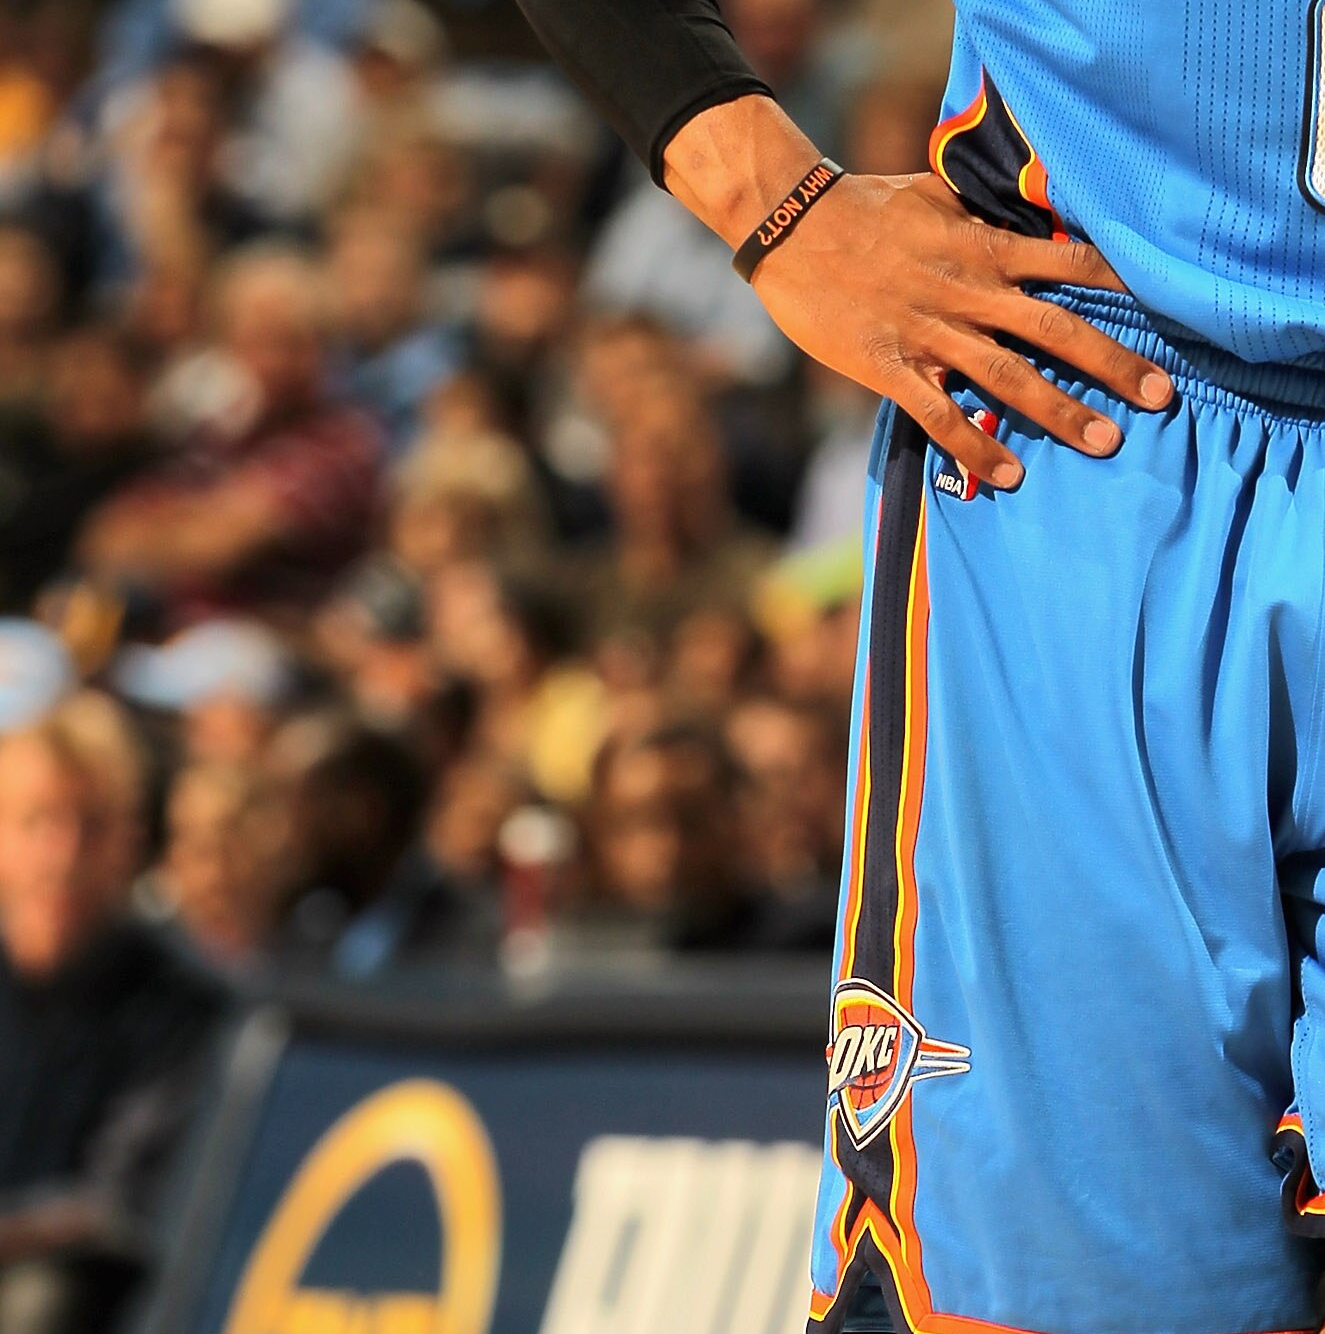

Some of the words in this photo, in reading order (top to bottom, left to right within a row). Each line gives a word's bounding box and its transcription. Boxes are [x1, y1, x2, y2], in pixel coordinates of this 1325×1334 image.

[799, 165, 834, 203] WHY
[757, 196, 803, 246] NOT?
[935, 472, 962, 495] NBA
[829, 1024, 898, 1097] OKC
